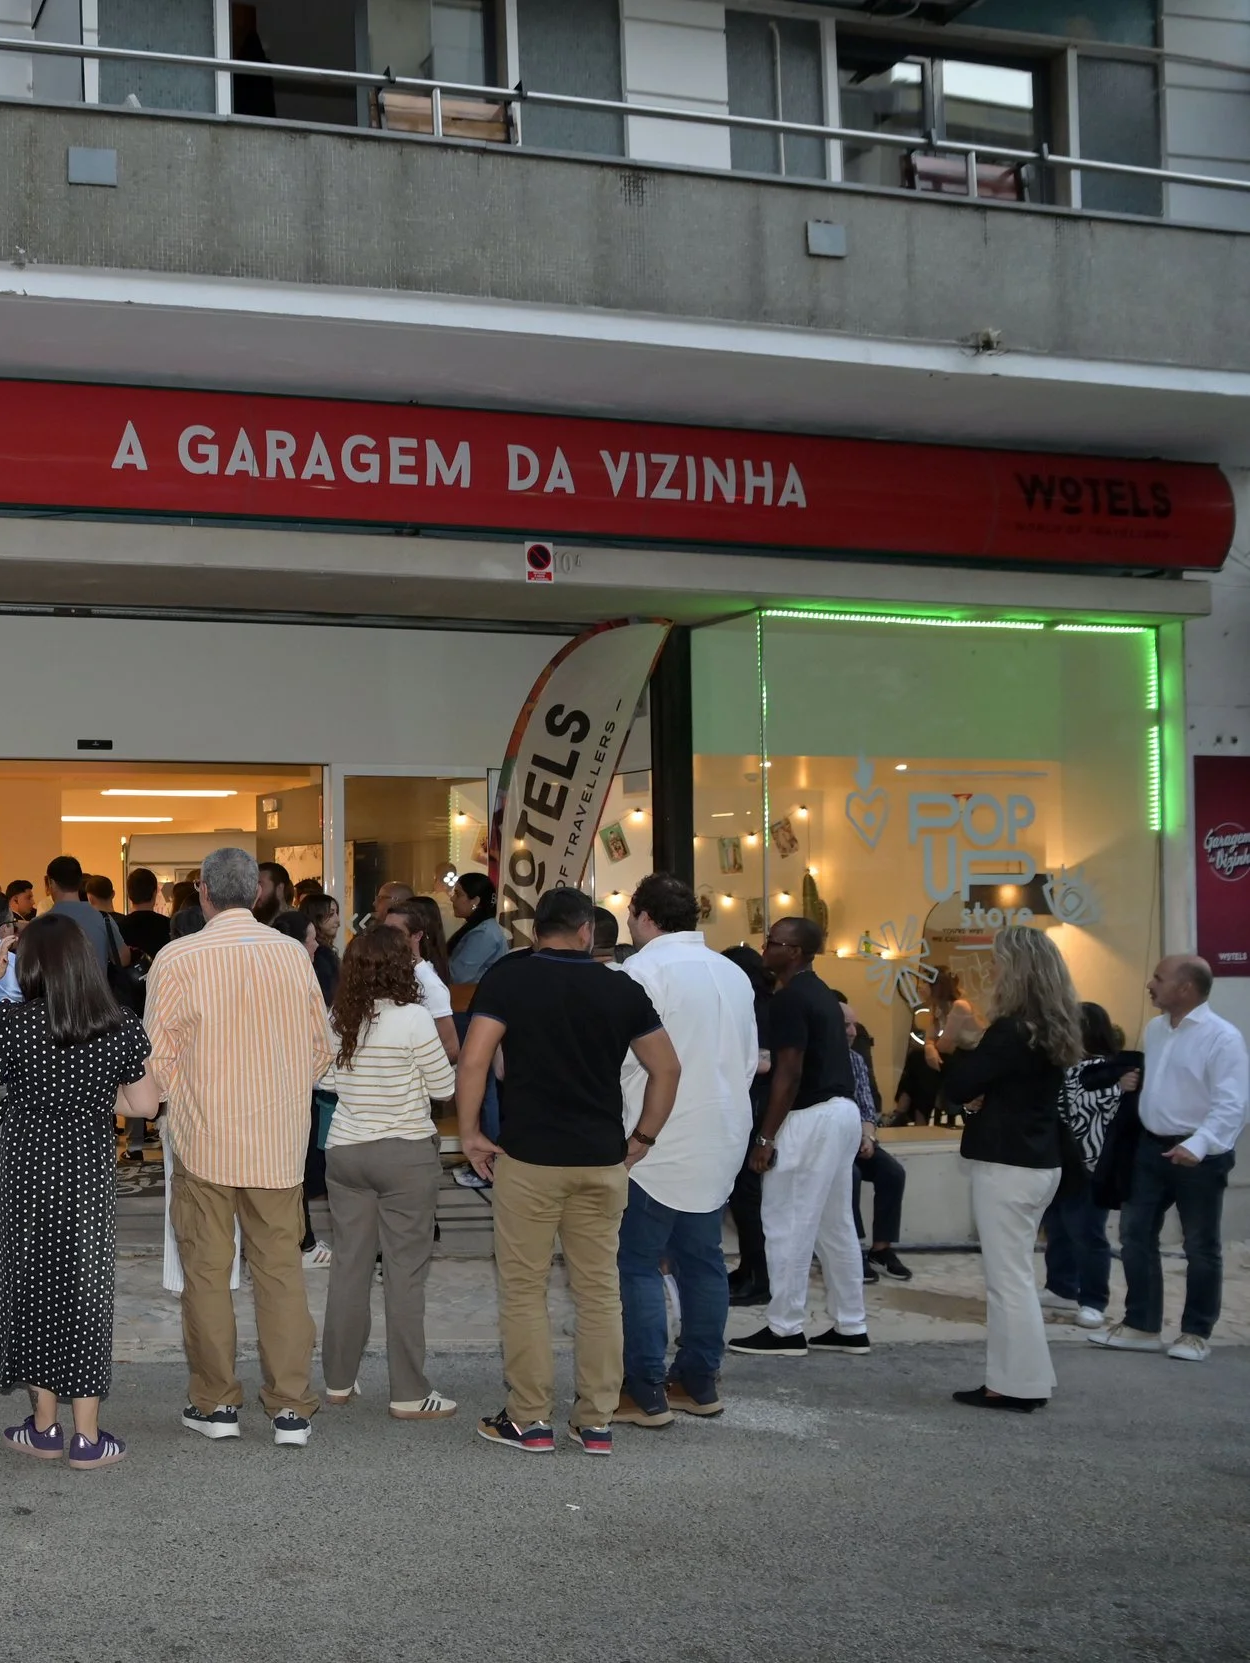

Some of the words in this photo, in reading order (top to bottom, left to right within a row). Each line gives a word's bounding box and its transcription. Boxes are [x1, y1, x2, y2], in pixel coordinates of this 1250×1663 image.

[111, 420, 148, 471] A
[177, 425, 471, 488] GARAGEM
[507, 444, 575, 494] DA
[599, 449, 807, 508] VIZINHA
[1014, 472, 1172, 520] WOTELS
[564, 721, 616, 858] TRAVELLERS
[908, 792, 1035, 847] POP
[499, 703, 591, 948] WOTELS
[923, 834, 1036, 902] UP
[1215, 847, 1250, 876] Vizinh
[960, 901, 1034, 929] store
